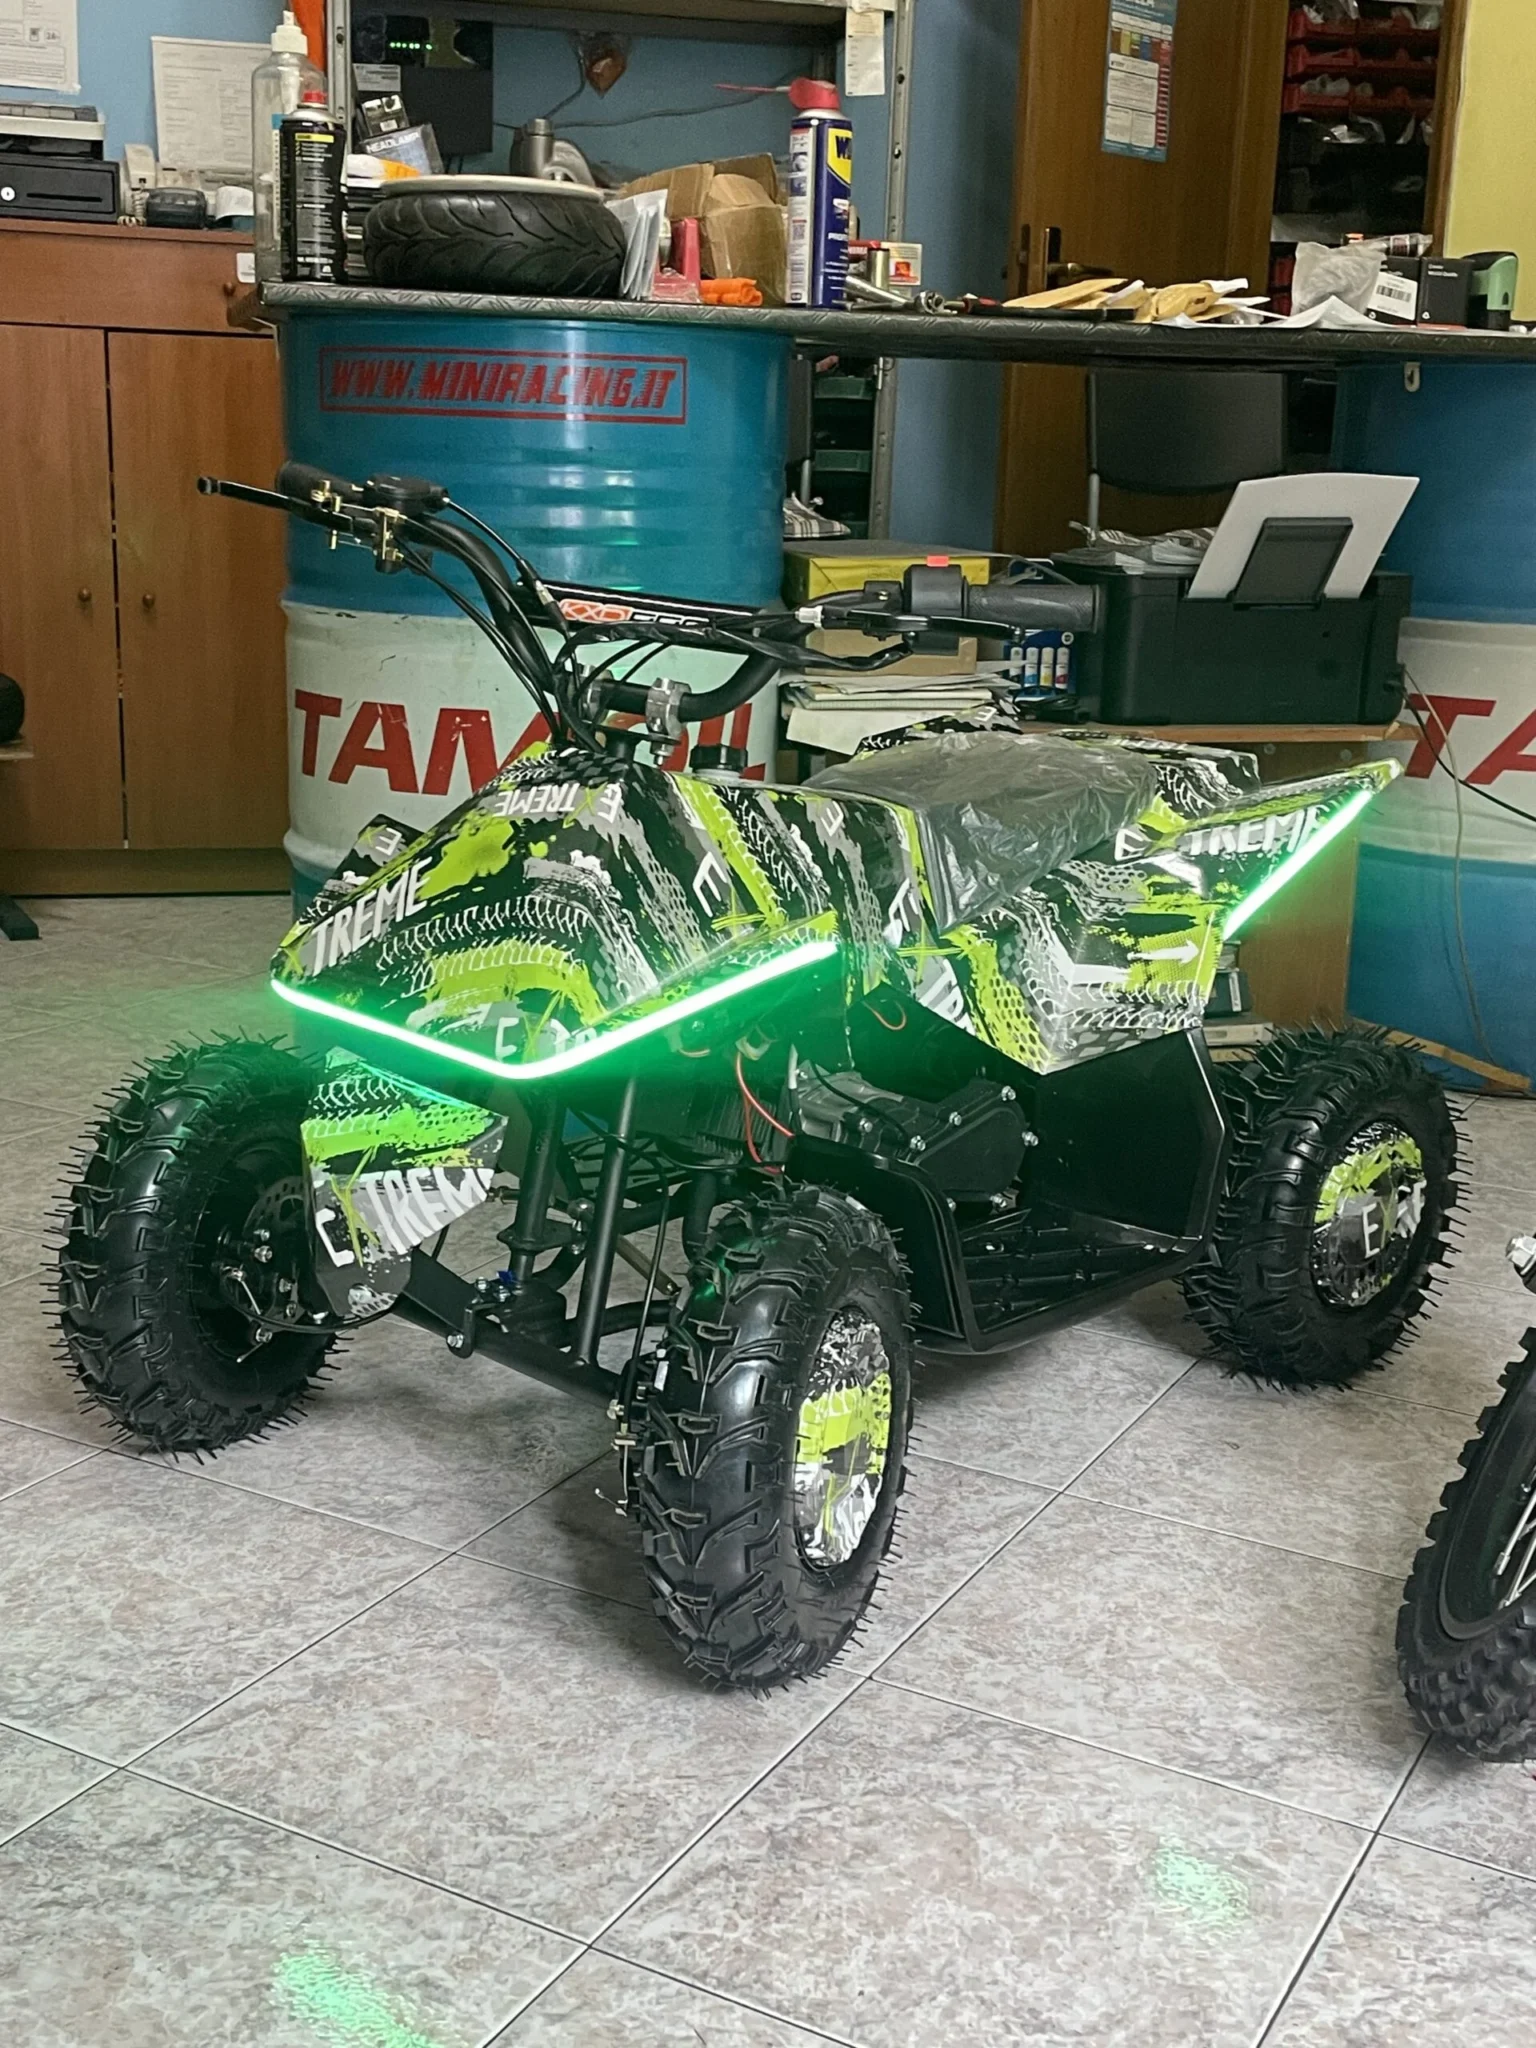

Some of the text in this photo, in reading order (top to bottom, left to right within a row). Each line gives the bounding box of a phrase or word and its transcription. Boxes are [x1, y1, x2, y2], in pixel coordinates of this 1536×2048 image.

[365, 131, 419, 154] HEADLAMP
[331, 359, 677, 409] WWW.MINIRACING.IT
[559, 599, 635, 624] KXD
